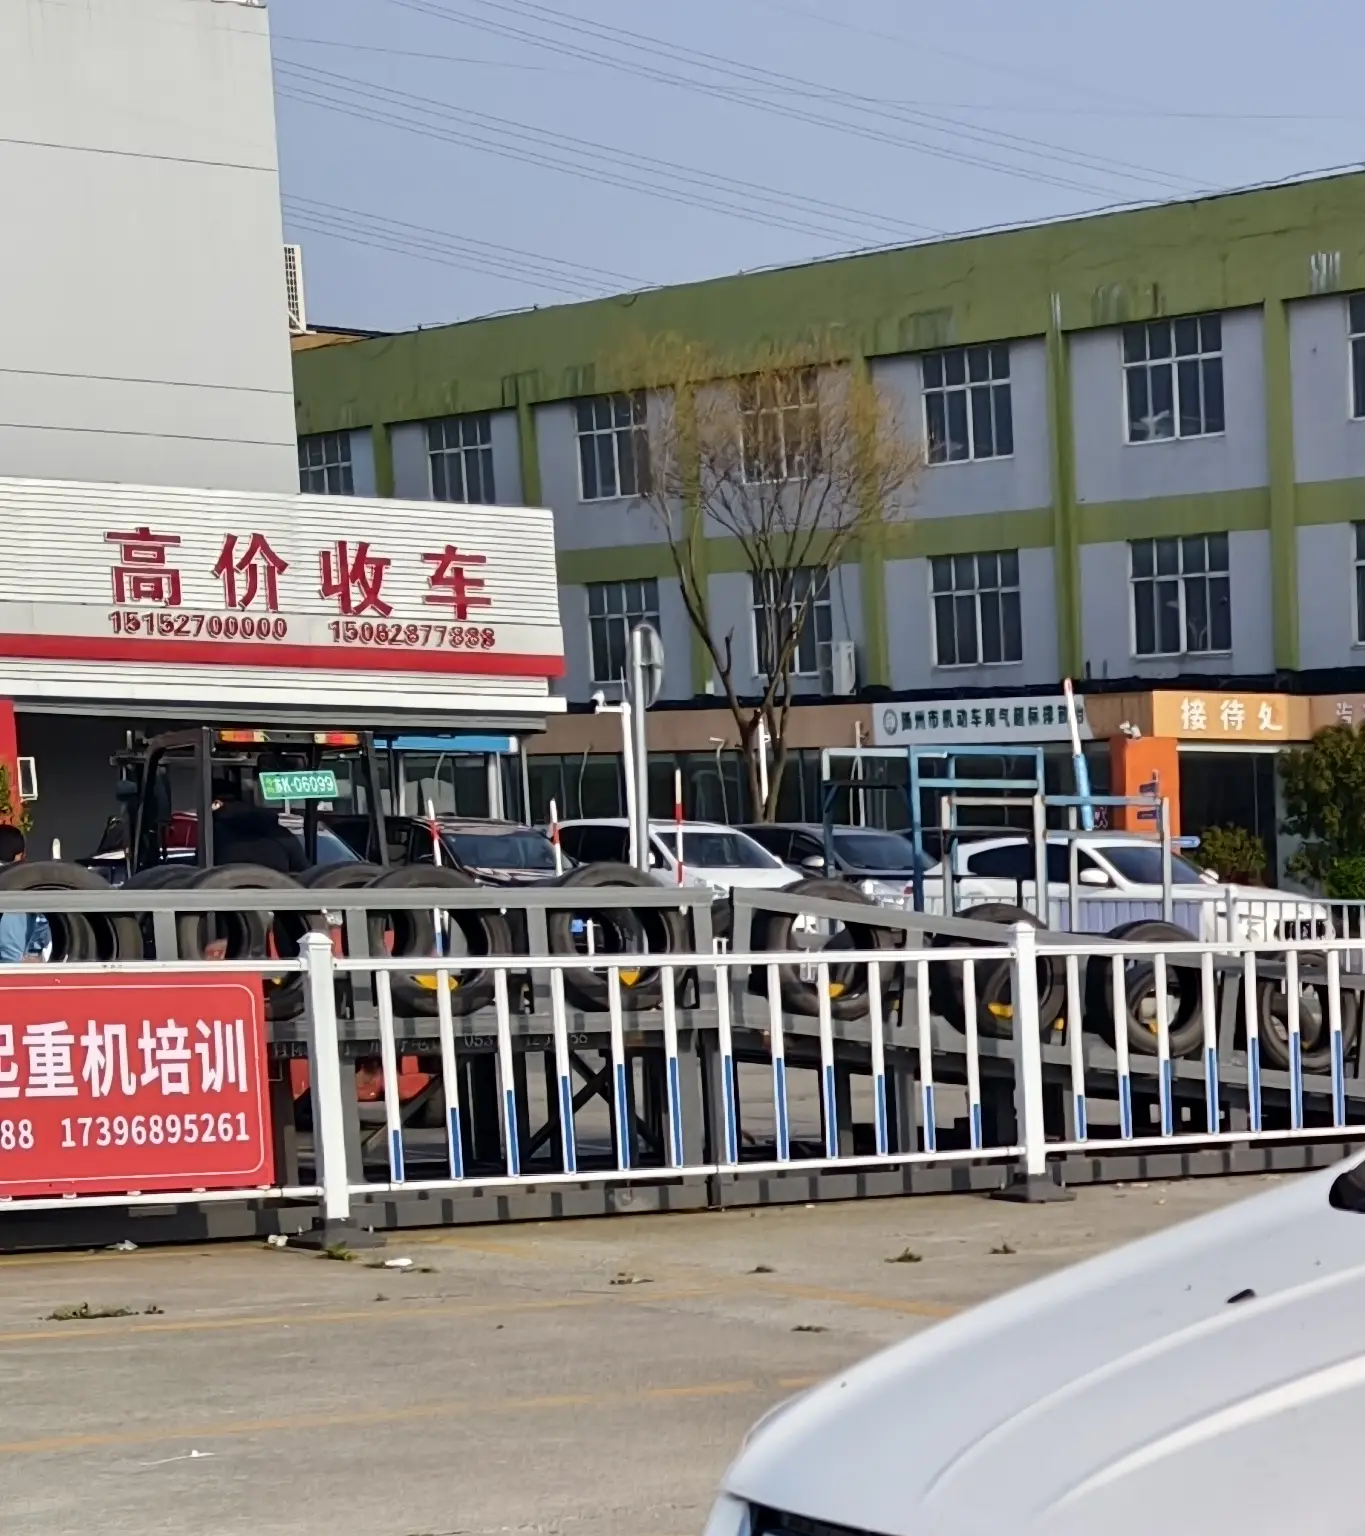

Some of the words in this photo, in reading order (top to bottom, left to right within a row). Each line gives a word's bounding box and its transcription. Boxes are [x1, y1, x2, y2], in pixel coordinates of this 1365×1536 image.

[104, 526, 492, 621] 高价收车
[108, 610, 288, 641] 15152700000
[60, 1112, 250, 1148] 17396895261
